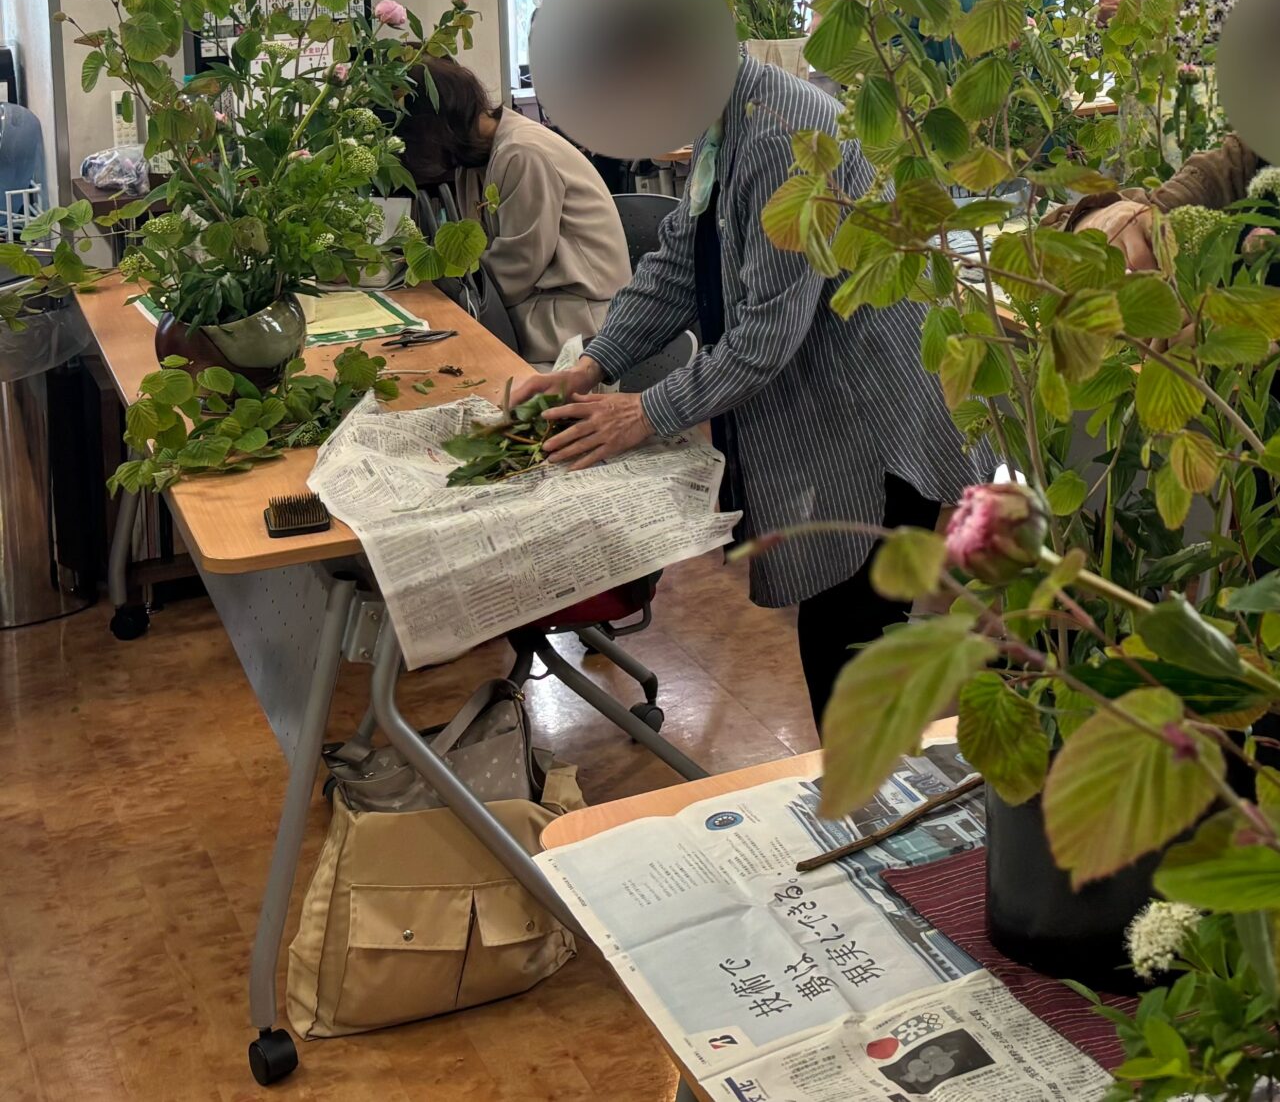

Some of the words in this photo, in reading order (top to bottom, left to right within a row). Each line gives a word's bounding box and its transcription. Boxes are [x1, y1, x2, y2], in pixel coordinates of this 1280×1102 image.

[719, 958, 792, 1017] 技術で
[784, 953, 839, 1001] 夢は
